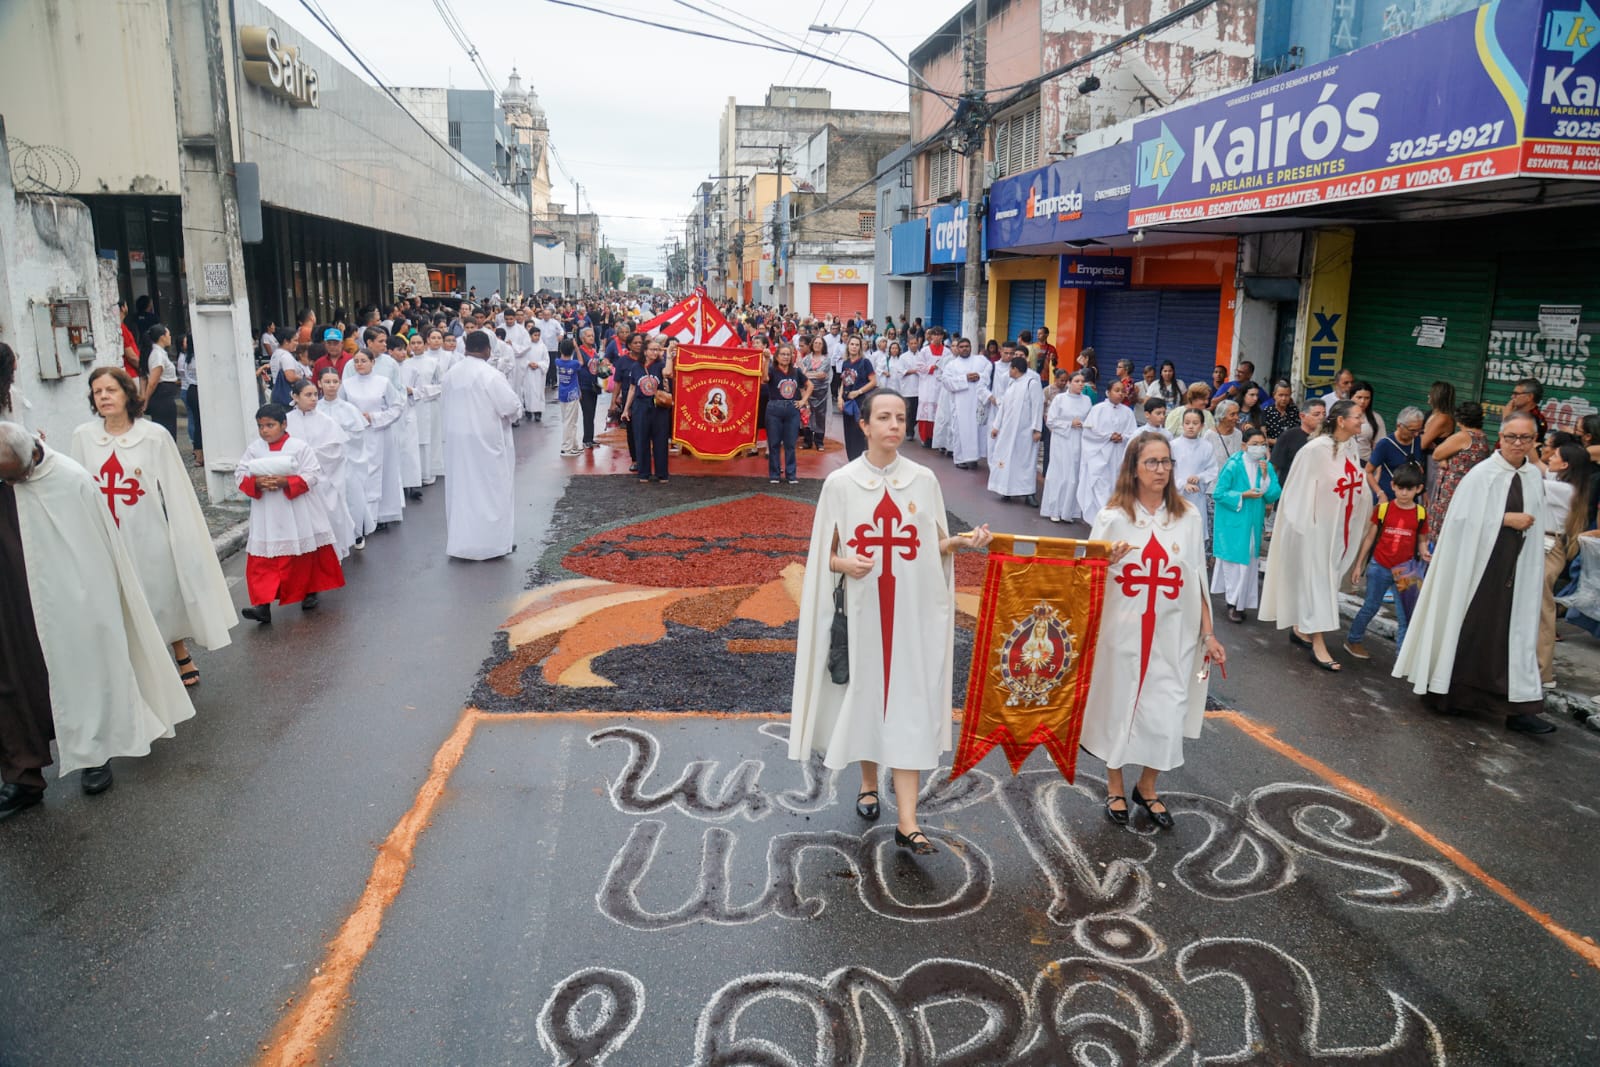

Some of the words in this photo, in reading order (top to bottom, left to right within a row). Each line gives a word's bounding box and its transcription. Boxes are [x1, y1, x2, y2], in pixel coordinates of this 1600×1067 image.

[265, 26, 320, 109] Safra
[1285, 75, 1309, 89] SENHOR
[1308, 71, 1322, 82] POR
[1541, 65, 1600, 107] Ka
[1550, 105, 1600, 116] PAPELARIA
[1191, 82, 1382, 183] Kairós
[1386, 120, 1505, 163] 3025-9921
[1526, 157, 1570, 171] ESTANTES,
[1571, 157, 1600, 171] BALCÃ
[1533, 143, 1573, 156] MATERIAL
[1133, 210, 1167, 225] MATERIAL
[1169, 205, 1205, 220] ESCOLAR,
[1207, 197, 1261, 216] ESCRITÓRIO,
[1264, 186, 1321, 209] ESTANTES,
[1325, 175, 1376, 198] BALCÃO
[1380, 174, 1401, 190] DE
[1404, 166, 1453, 187] VIDRO,
[1459, 158, 1497, 180] ETC.
[1209, 173, 1264, 195] PAPELARIA
[1266, 171, 1273, 185] E
[1277, 158, 1346, 182] PRESENTES
[1033, 189, 1083, 219] Empresta
[837, 268, 861, 280] SOL
[1077, 263, 1125, 276] Empresta
[1486, 358, 1588, 388] RESSORAS
